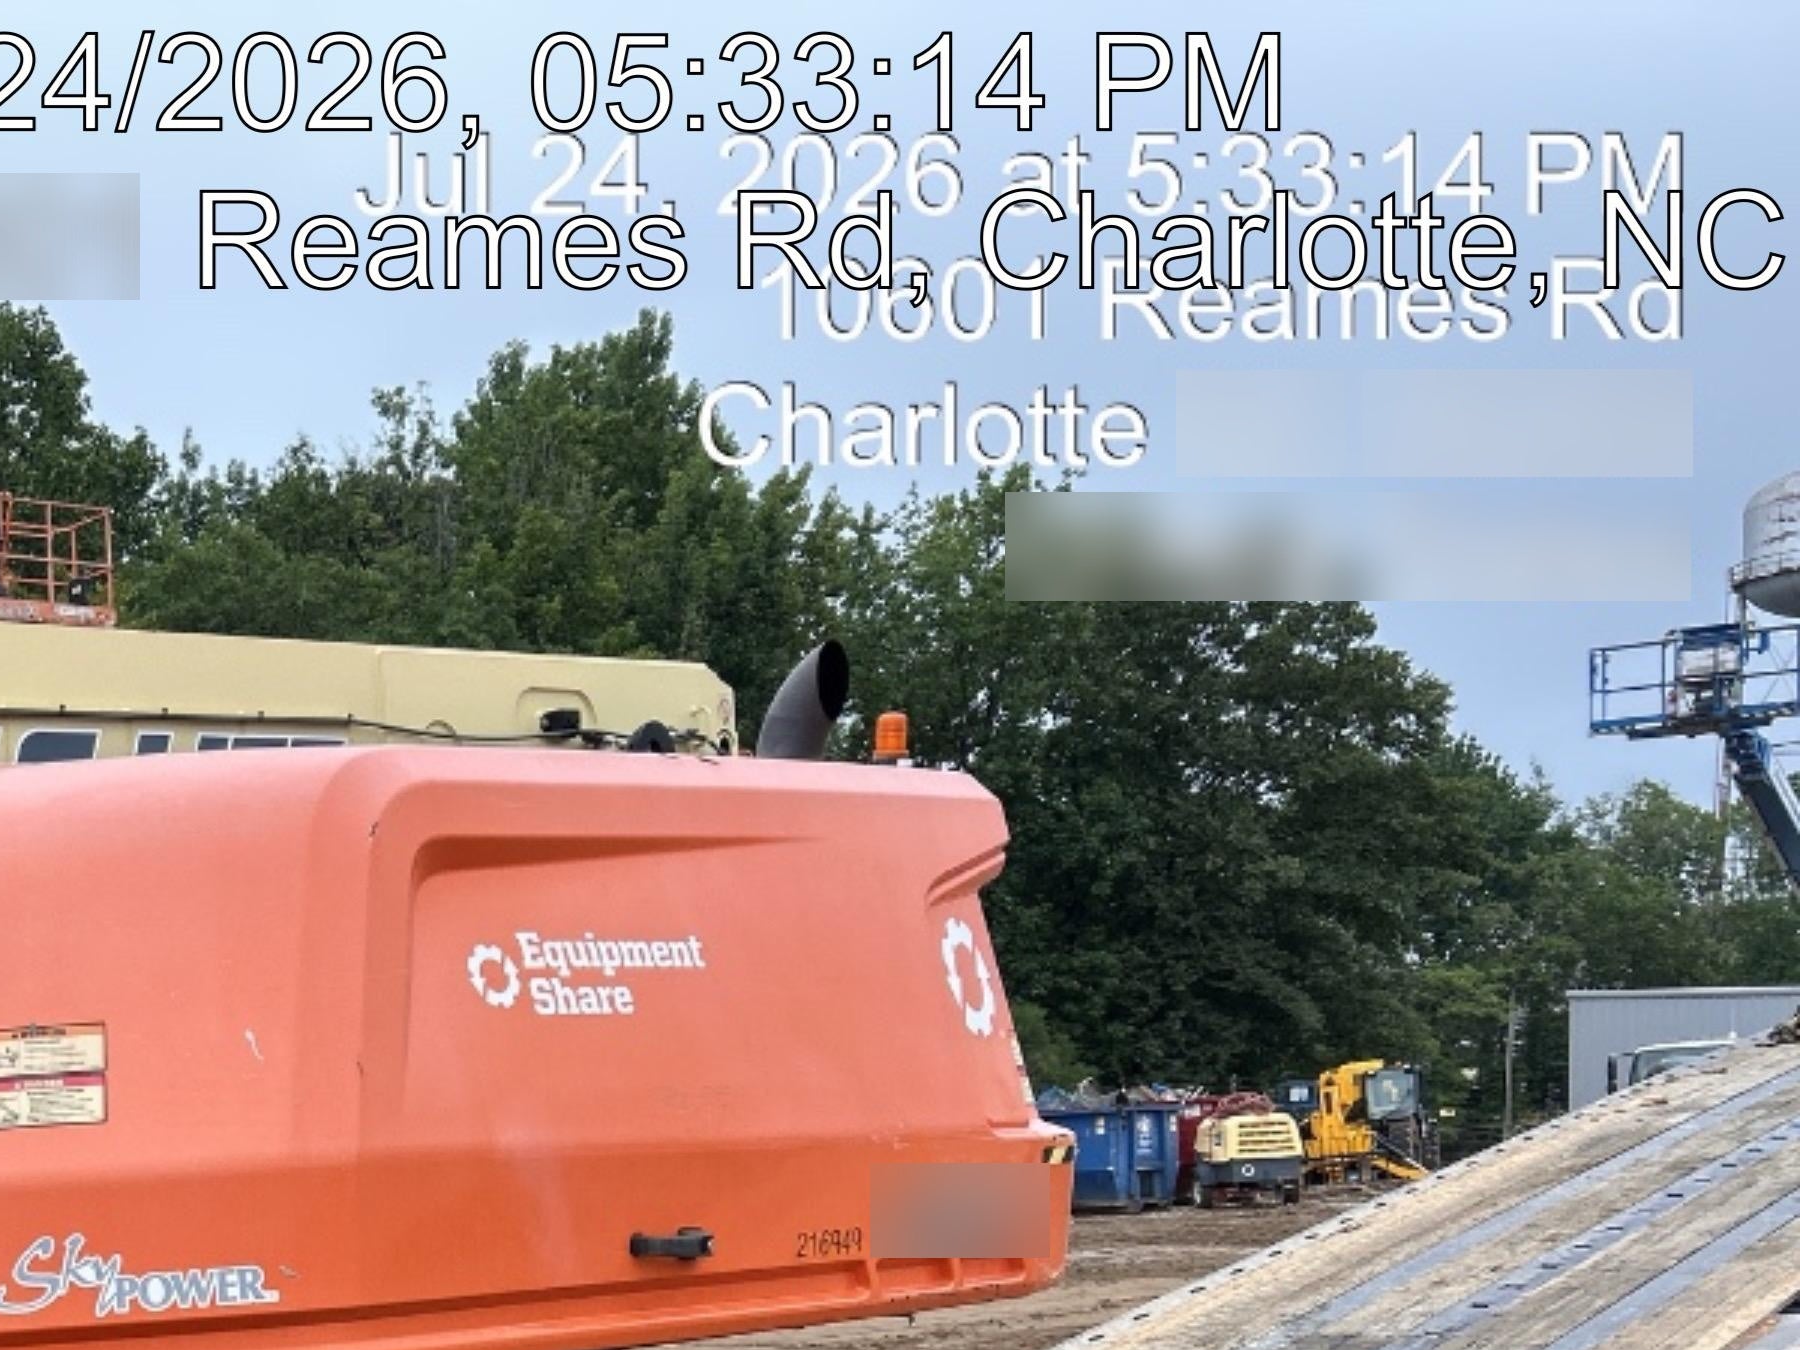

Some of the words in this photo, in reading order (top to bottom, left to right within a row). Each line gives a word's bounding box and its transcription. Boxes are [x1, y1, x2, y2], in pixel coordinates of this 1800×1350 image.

[514, 931, 706, 977] Equipment
[529, 976, 634, 1016] Share
[797, 1226, 863, 1258] 216949
